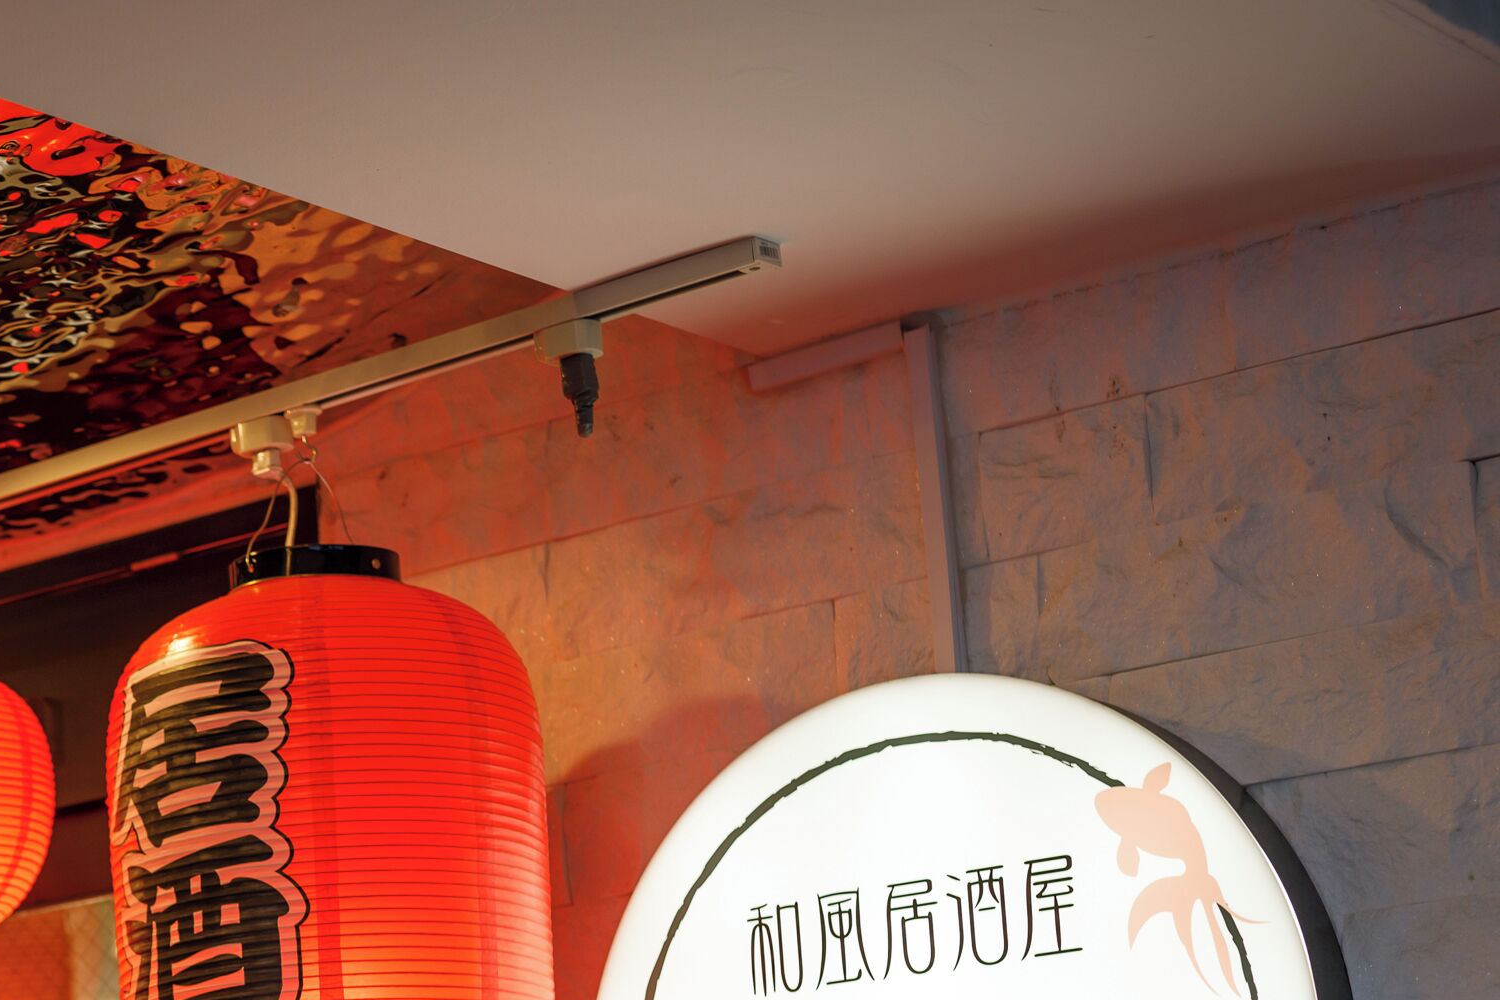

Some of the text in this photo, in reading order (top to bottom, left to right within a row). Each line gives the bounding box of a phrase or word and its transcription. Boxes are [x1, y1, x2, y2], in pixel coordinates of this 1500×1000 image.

[746, 854, 1083, 998] 和風居酒屋
